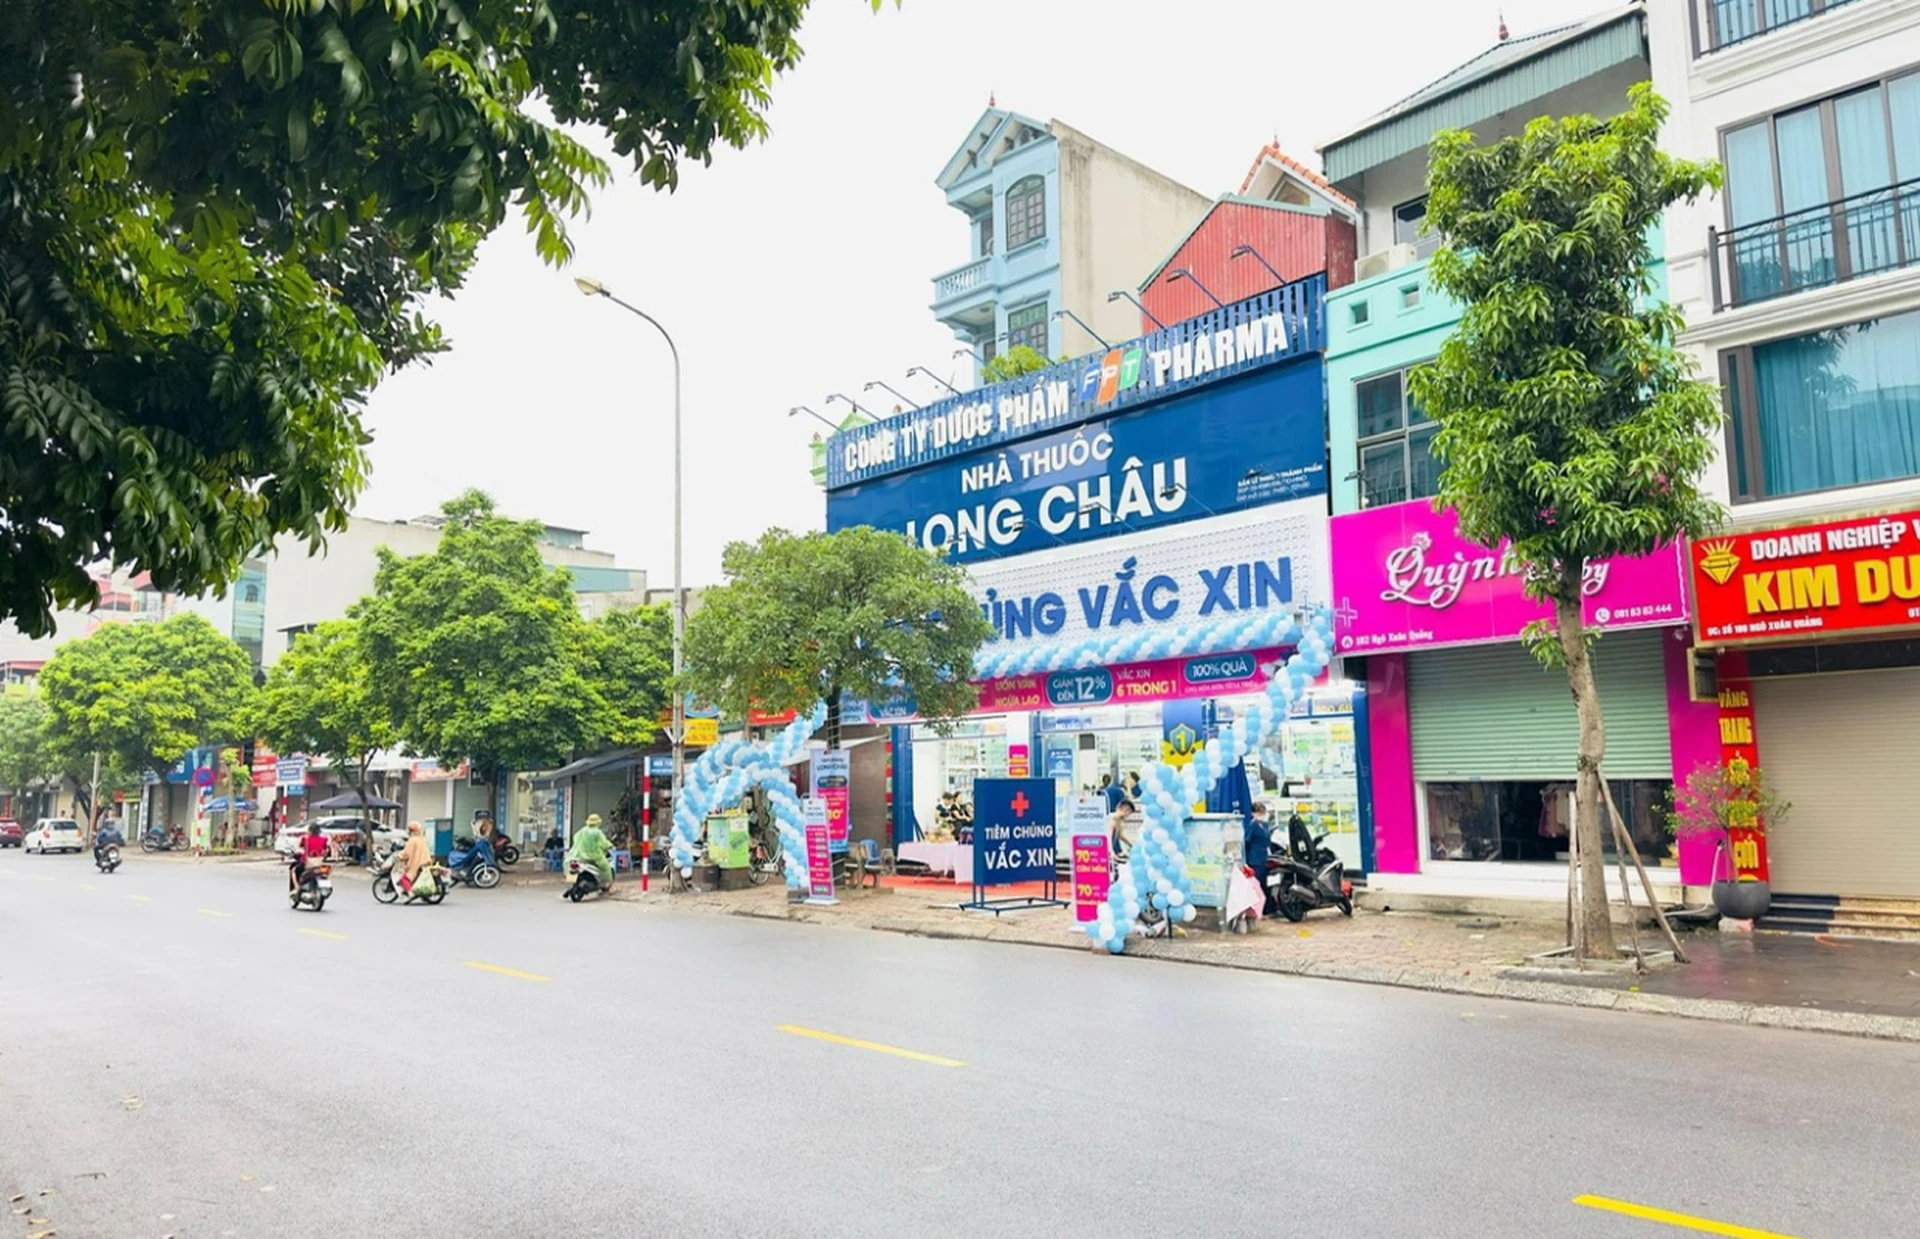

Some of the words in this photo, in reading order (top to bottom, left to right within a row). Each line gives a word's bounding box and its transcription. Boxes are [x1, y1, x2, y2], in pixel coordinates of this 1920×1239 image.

[844, 429, 896, 473] CÔNG
[901, 419, 928, 457] TY
[932, 402, 993, 447] DƯỢC
[999, 379, 1069, 433] PHẨM
[1081, 351, 1140, 401] FPT
[961, 453, 1012, 494] NHÀ
[1020, 424, 1114, 479] THUỐC
[1038, 451, 1189, 537] CHÂU
[1750, 532, 1822, 562] DOANH
[1827, 518, 1907, 549] NGHIỆP
[1077, 556, 1180, 630] VẮC
[1198, 556, 1294, 616] XIN
[1743, 564, 1840, 614] KIM
[1117, 667, 1134, 681] VẮC
[1135, 668, 1151, 679] XIN
[1192, 663, 1220, 678] 100%
[1220, 656, 1248, 676] QUÀ
[1117, 684, 1125, 698] 6
[1126, 680, 1169, 696] TRONG
[1171, 680, 1177, 694] 1
[984, 822, 1010, 841] TIÊM
[1013, 821, 1053, 839] CHỦNG
[984, 841, 1022, 870] VẮC
[1026, 847, 1054, 868] XIN
[1075, 849, 1090, 864] 70
[1077, 883, 1092, 898] 70
